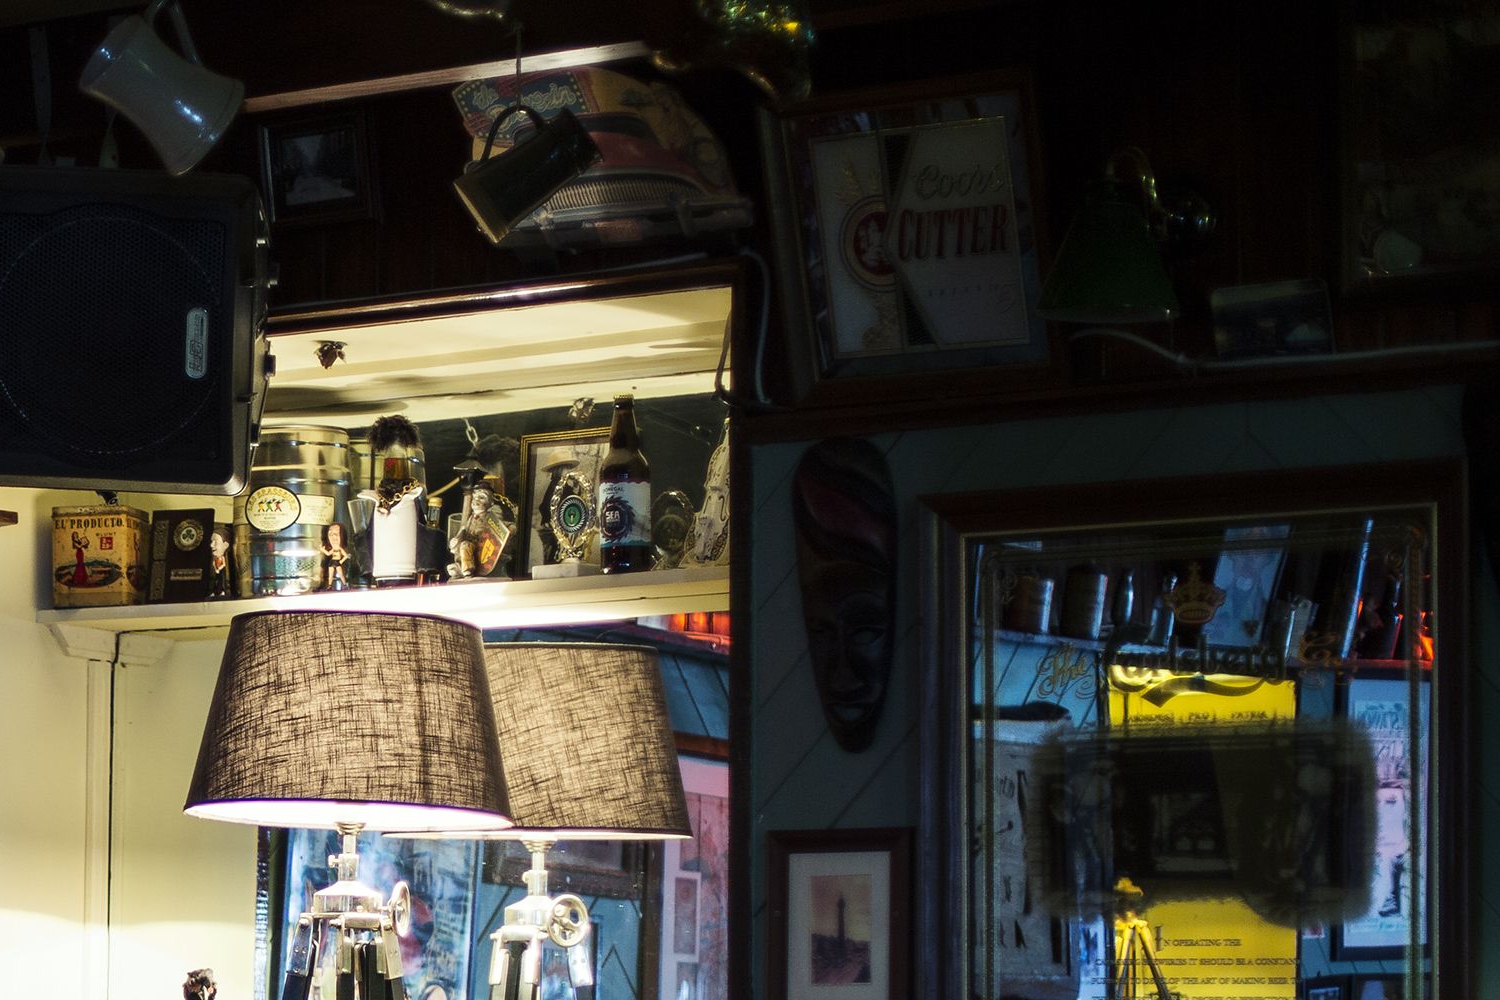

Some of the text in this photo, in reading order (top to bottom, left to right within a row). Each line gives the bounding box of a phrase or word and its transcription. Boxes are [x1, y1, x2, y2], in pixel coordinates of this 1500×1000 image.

[899, 205, 1010, 260] CUTTER
[605, 510, 620, 520] SEA
[55, 518, 66, 530] EL
